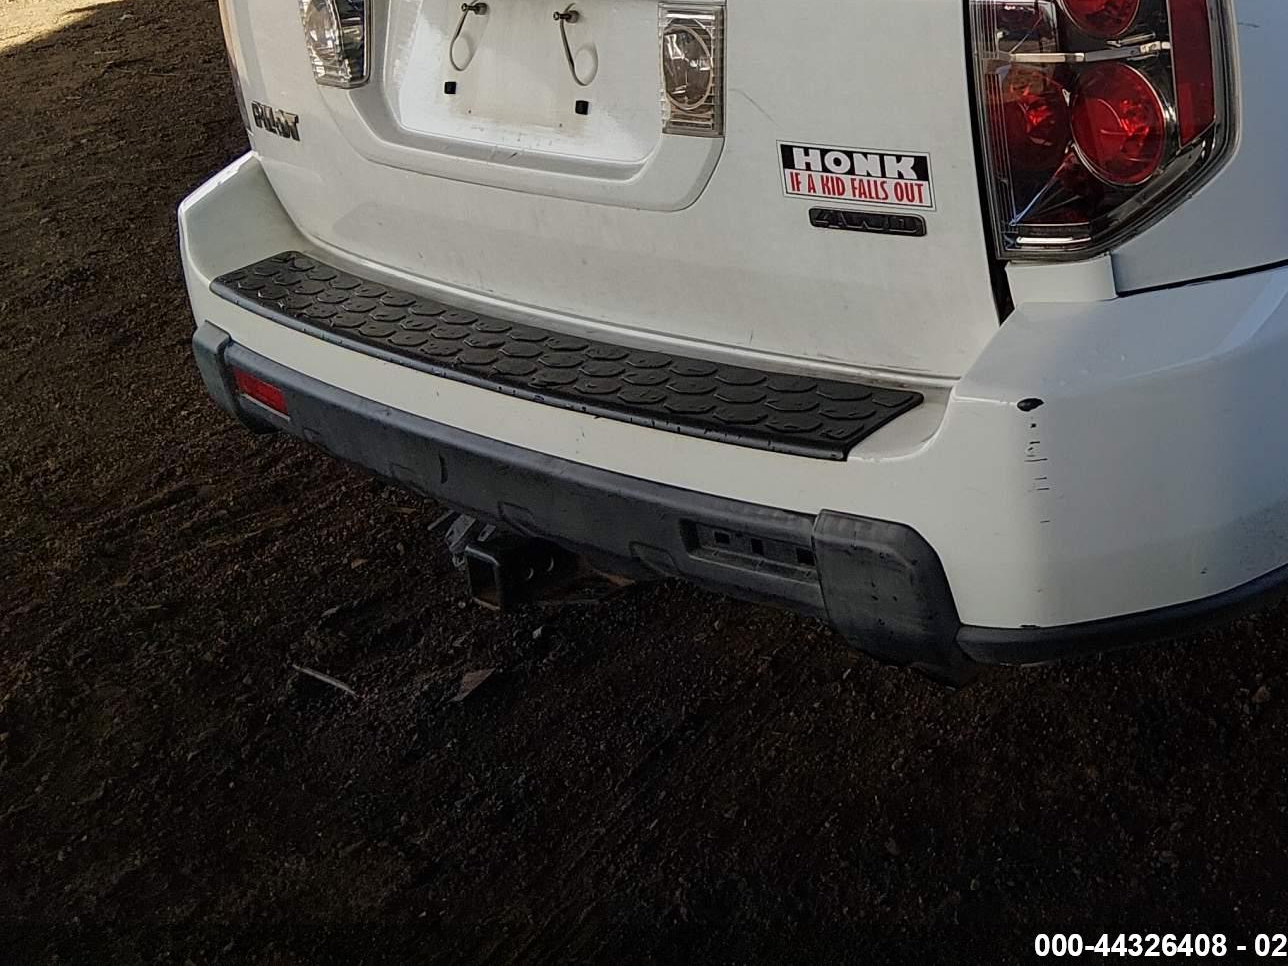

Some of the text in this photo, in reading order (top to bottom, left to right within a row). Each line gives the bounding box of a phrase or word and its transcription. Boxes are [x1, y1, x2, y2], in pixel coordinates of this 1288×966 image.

[791, 146, 918, 180] HONK
[789, 171, 924, 204] IF A KID FALLS OUT
[813, 209, 919, 233] 4WD
